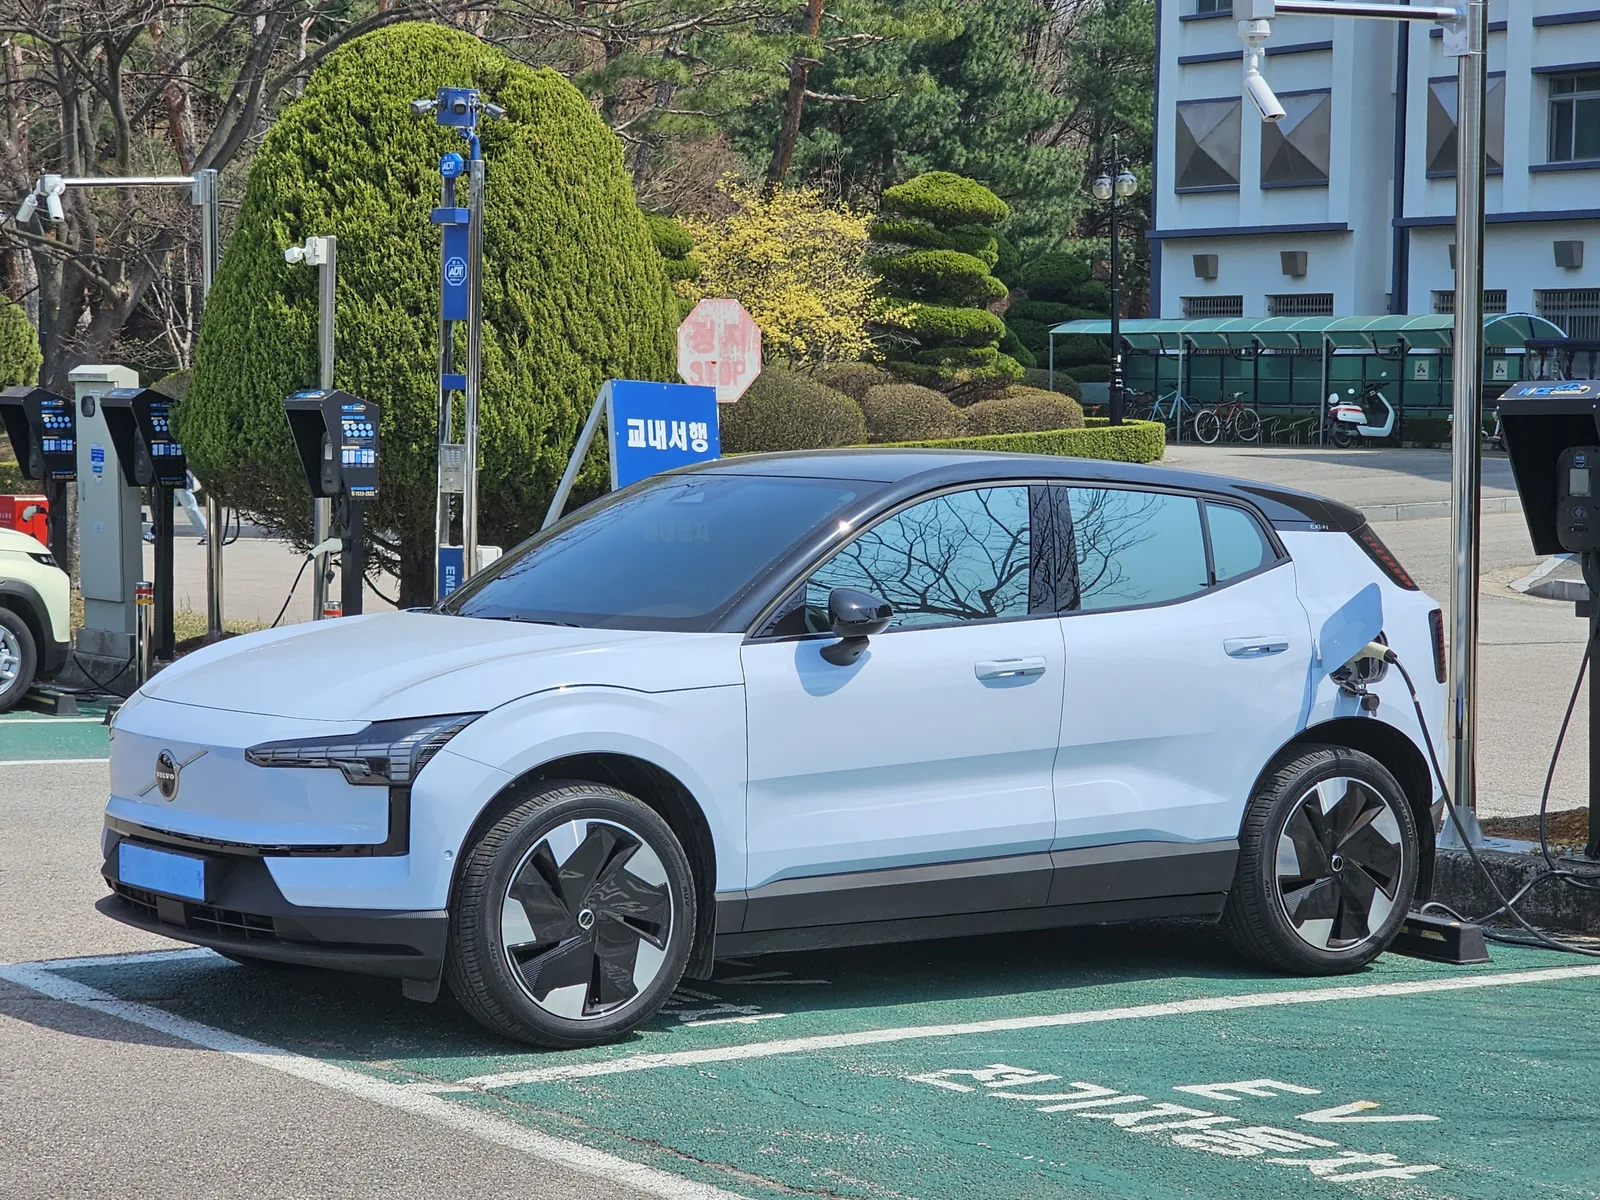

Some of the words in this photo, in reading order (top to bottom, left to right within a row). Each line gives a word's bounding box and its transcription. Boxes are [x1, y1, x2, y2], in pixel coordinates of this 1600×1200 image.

[442, 161, 455, 170] ADT
[449, 266, 463, 276] ADT
[689, 360, 746, 386] STOP
[1518, 388, 1554, 396] NICE
[627, 418, 709, 452] 교내서행
[156, 771, 175, 780] VOLVO
[1173, 1079, 1440, 1122] EV
[906, 1063, 1441, 1182] 전기자동차
